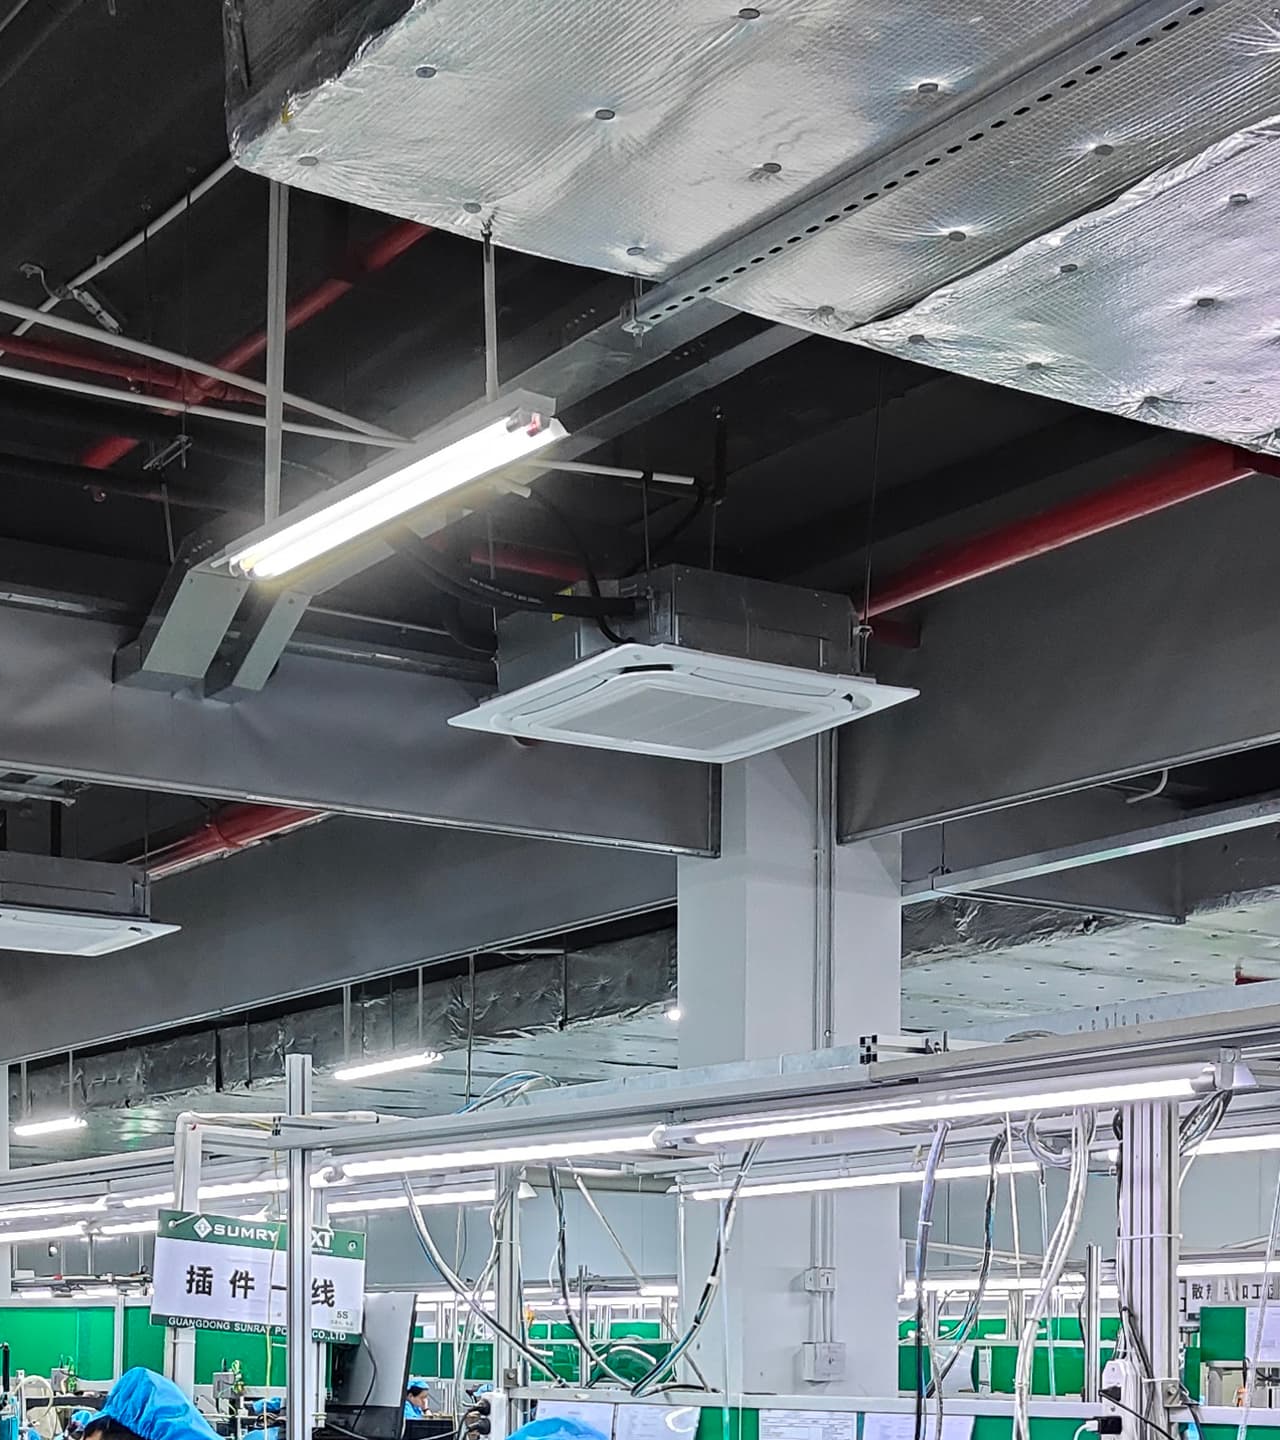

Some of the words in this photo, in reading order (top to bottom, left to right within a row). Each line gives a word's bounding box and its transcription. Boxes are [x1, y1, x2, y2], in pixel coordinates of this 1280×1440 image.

[213, 1224, 278, 1242] SUMRY
[168, 1316, 230, 1331] GUANGDONG
[234, 1322, 271, 1334] SUNRAY
